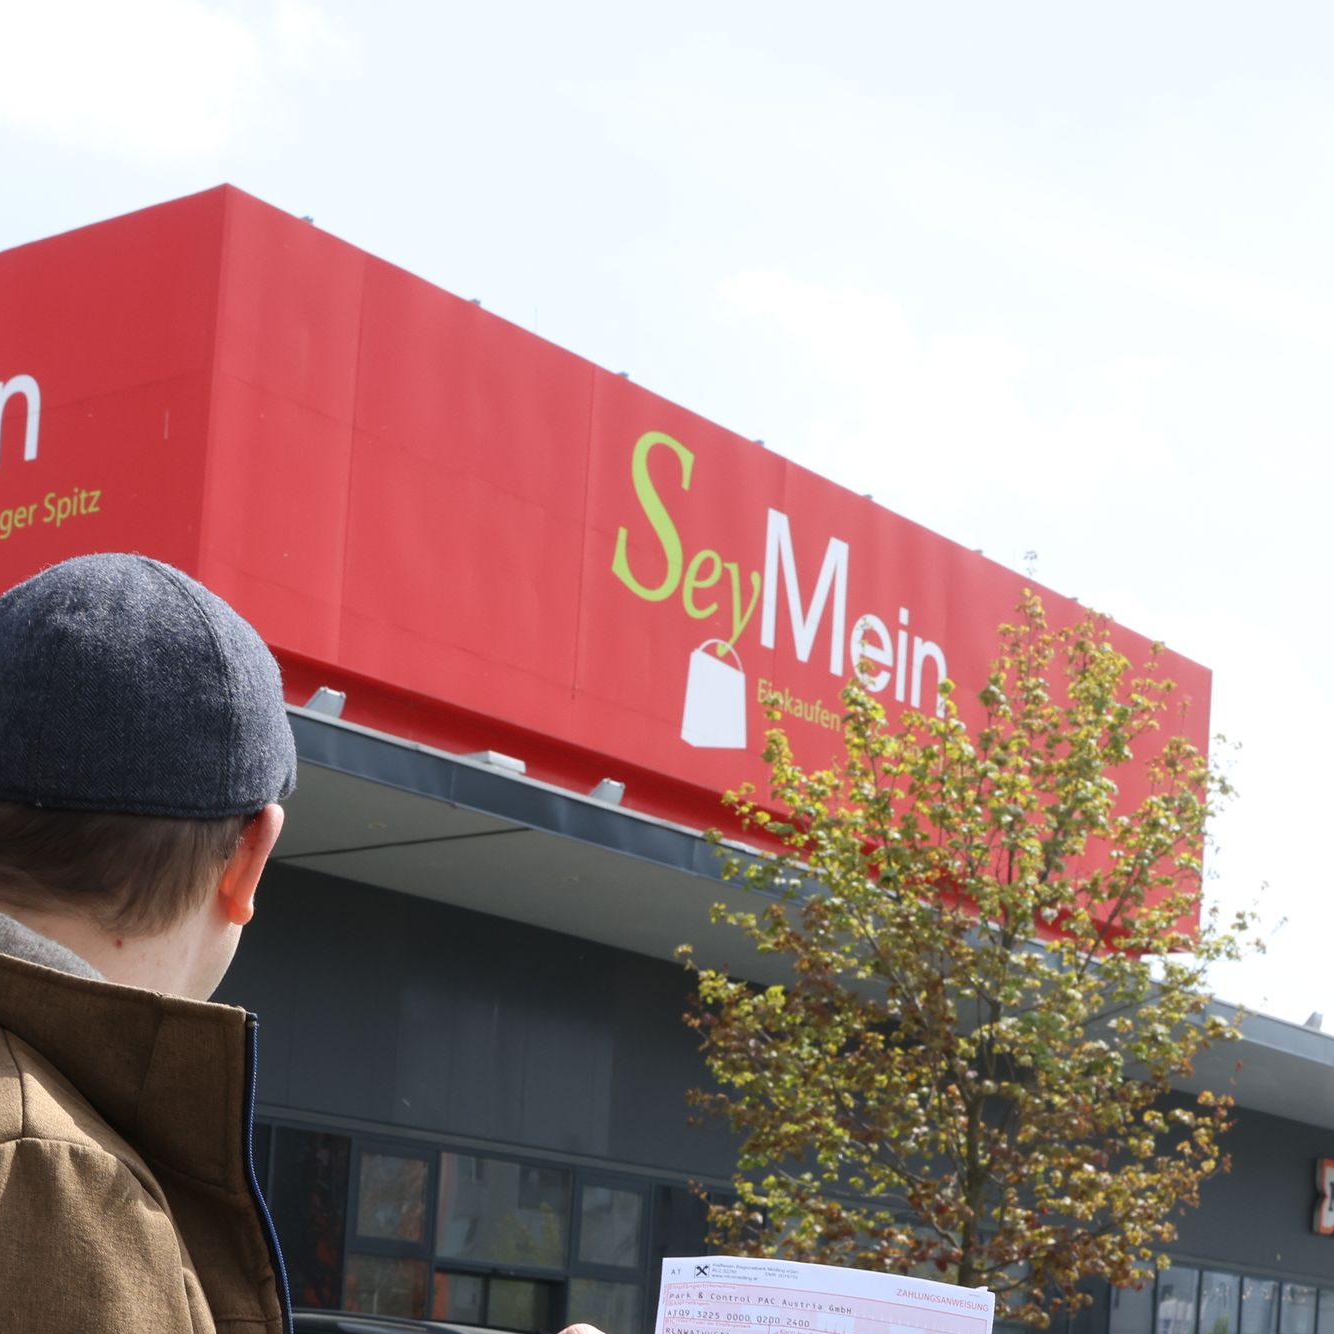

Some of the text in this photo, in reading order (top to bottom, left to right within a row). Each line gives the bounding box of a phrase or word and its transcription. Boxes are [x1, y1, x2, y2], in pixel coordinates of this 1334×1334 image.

[43, 487, 101, 527] Spitz
[669, 1291, 852, 1314] Park & Control PAC Austria GmbH
[896, 1288, 989, 1312] ZAHLUNGSANWEISUNG
[697, 1311, 720, 1319] 3225
[726, 1313, 751, 1322] 0000
[756, 1315, 781, 1324] 0200
[786, 1318, 810, 1327] 2400
